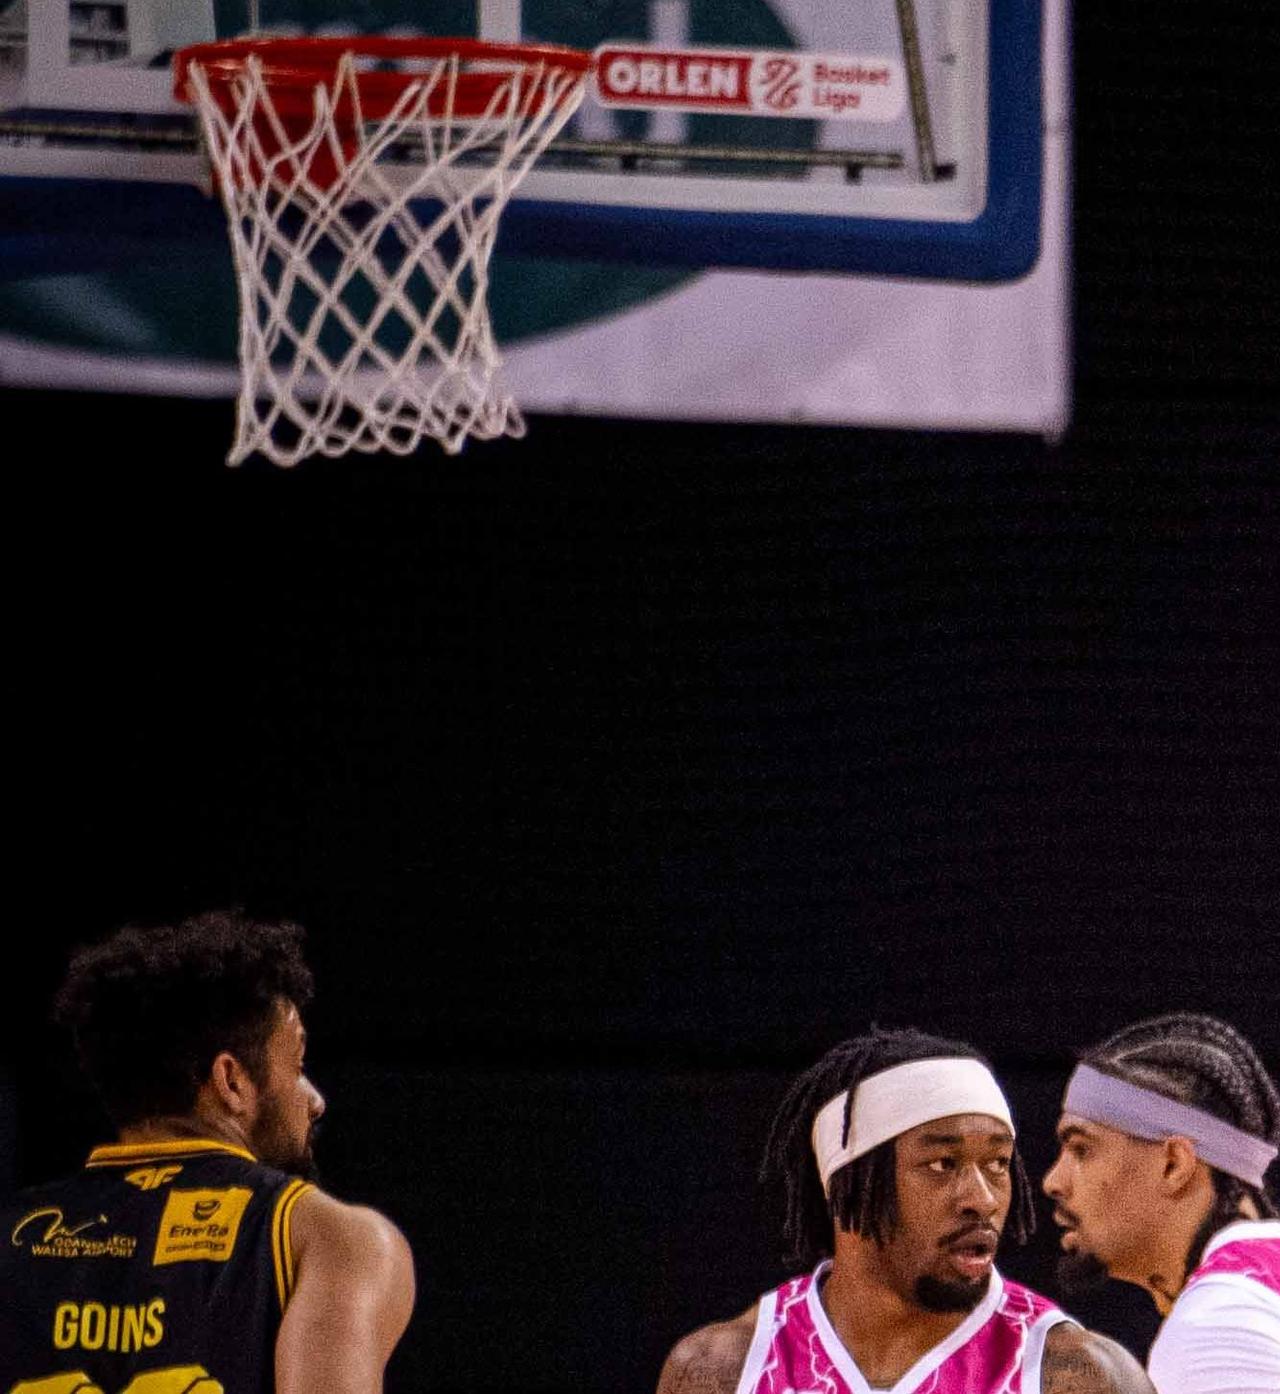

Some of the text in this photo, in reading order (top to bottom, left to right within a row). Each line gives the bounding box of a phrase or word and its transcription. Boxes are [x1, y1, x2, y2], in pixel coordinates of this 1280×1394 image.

[606, 58, 741, 99] ORLEN
[813, 62, 890, 86] Basket
[812, 88, 860, 112] Liga
[53, 1299, 166, 1353] GOINS
